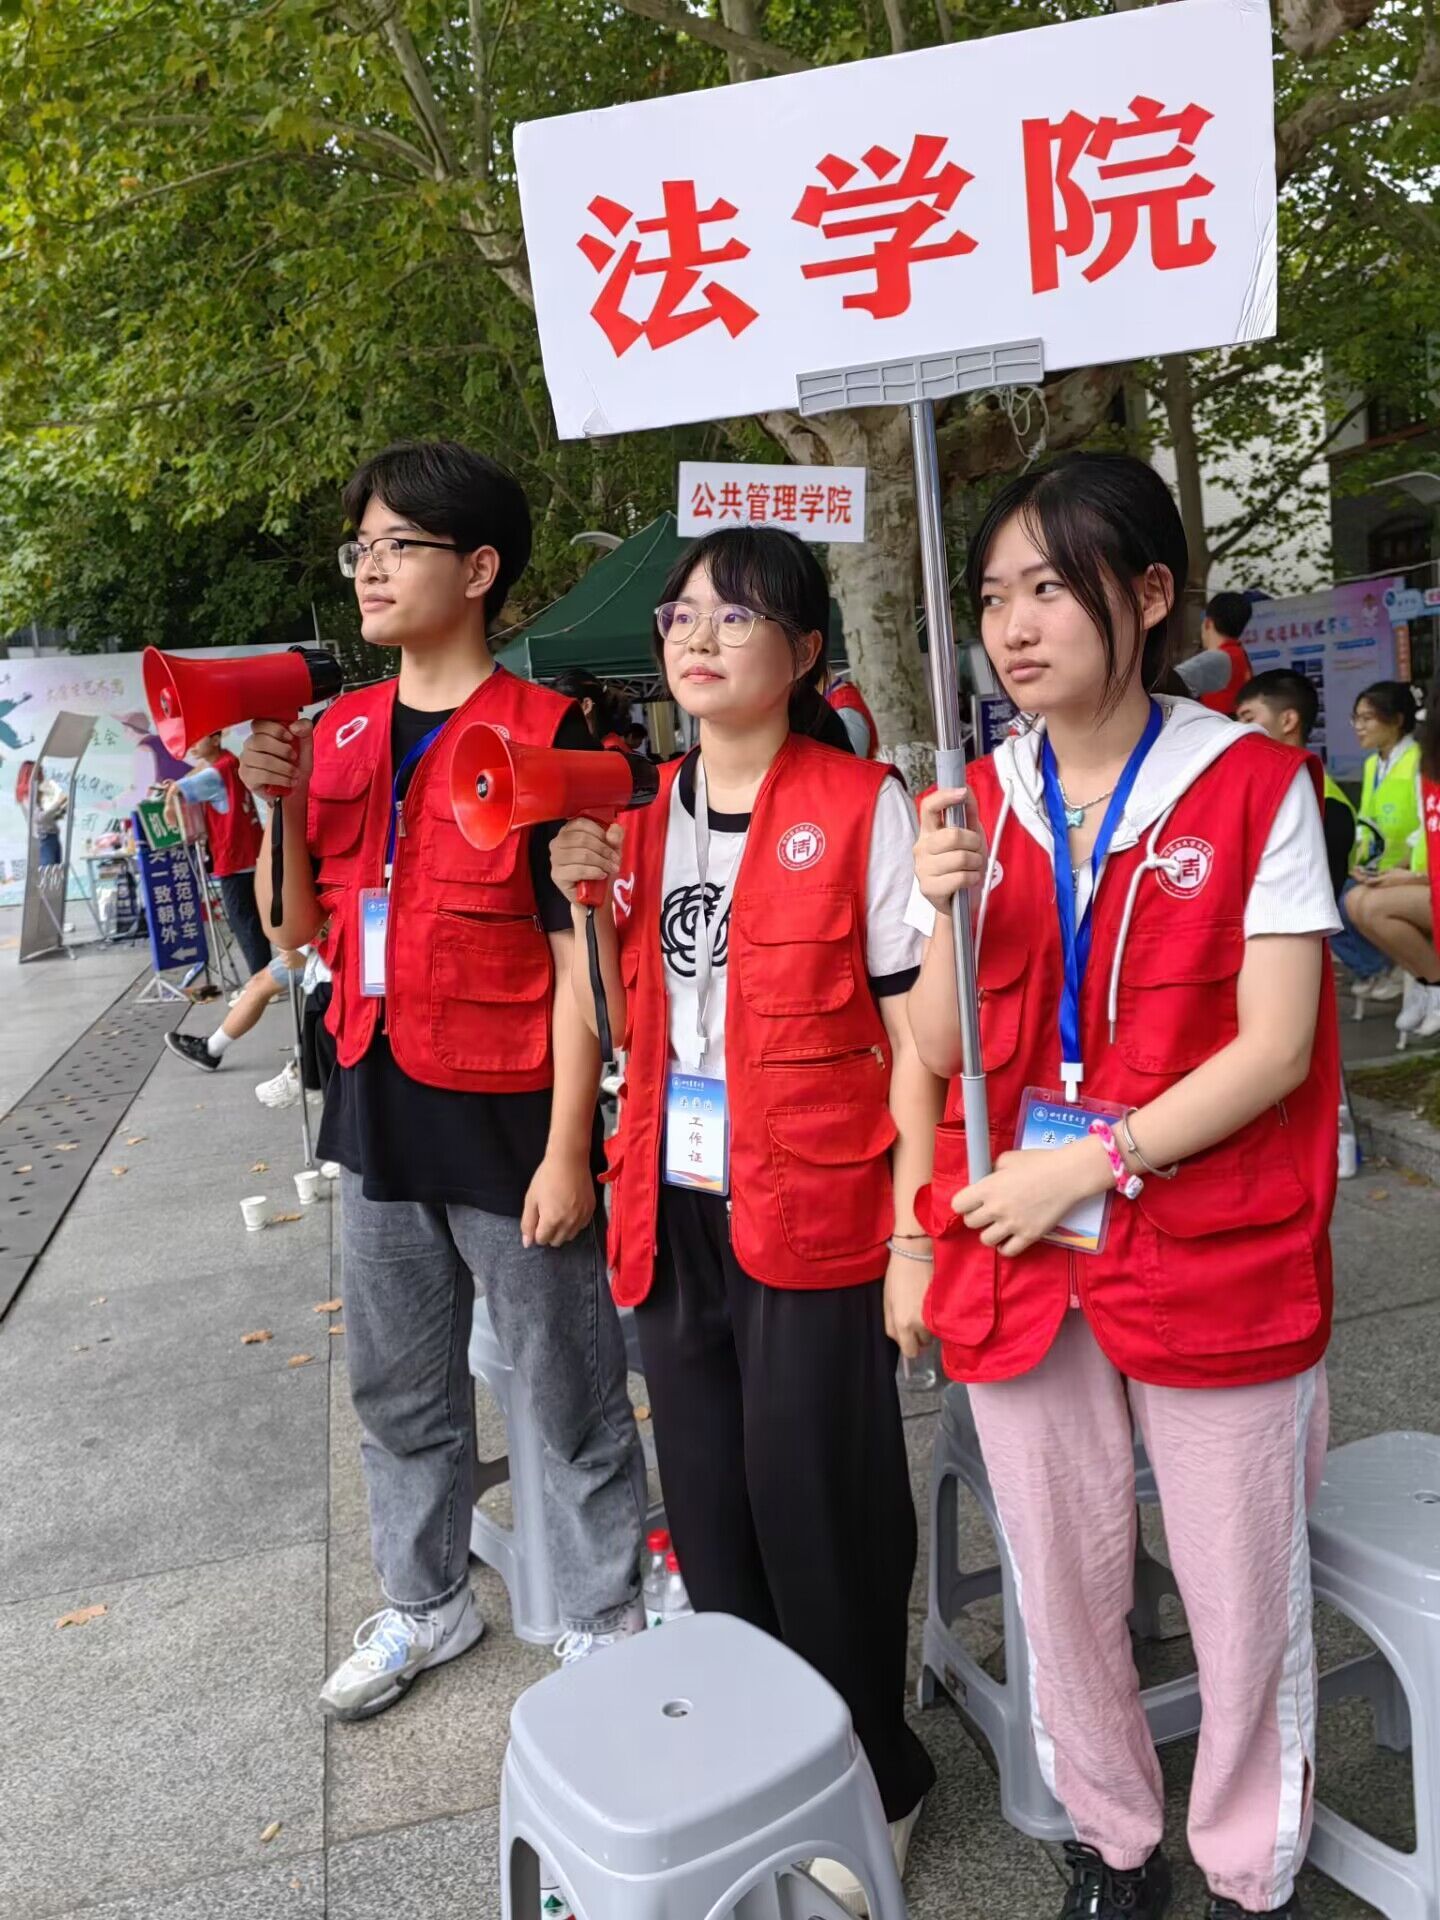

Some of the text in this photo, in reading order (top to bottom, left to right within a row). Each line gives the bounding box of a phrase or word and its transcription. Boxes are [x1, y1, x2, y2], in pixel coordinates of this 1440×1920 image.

[577, 94, 1217, 359] 法学院
[691, 481, 852, 524] 公共管理学院
[688, 1116, 704, 1163] 工作证
